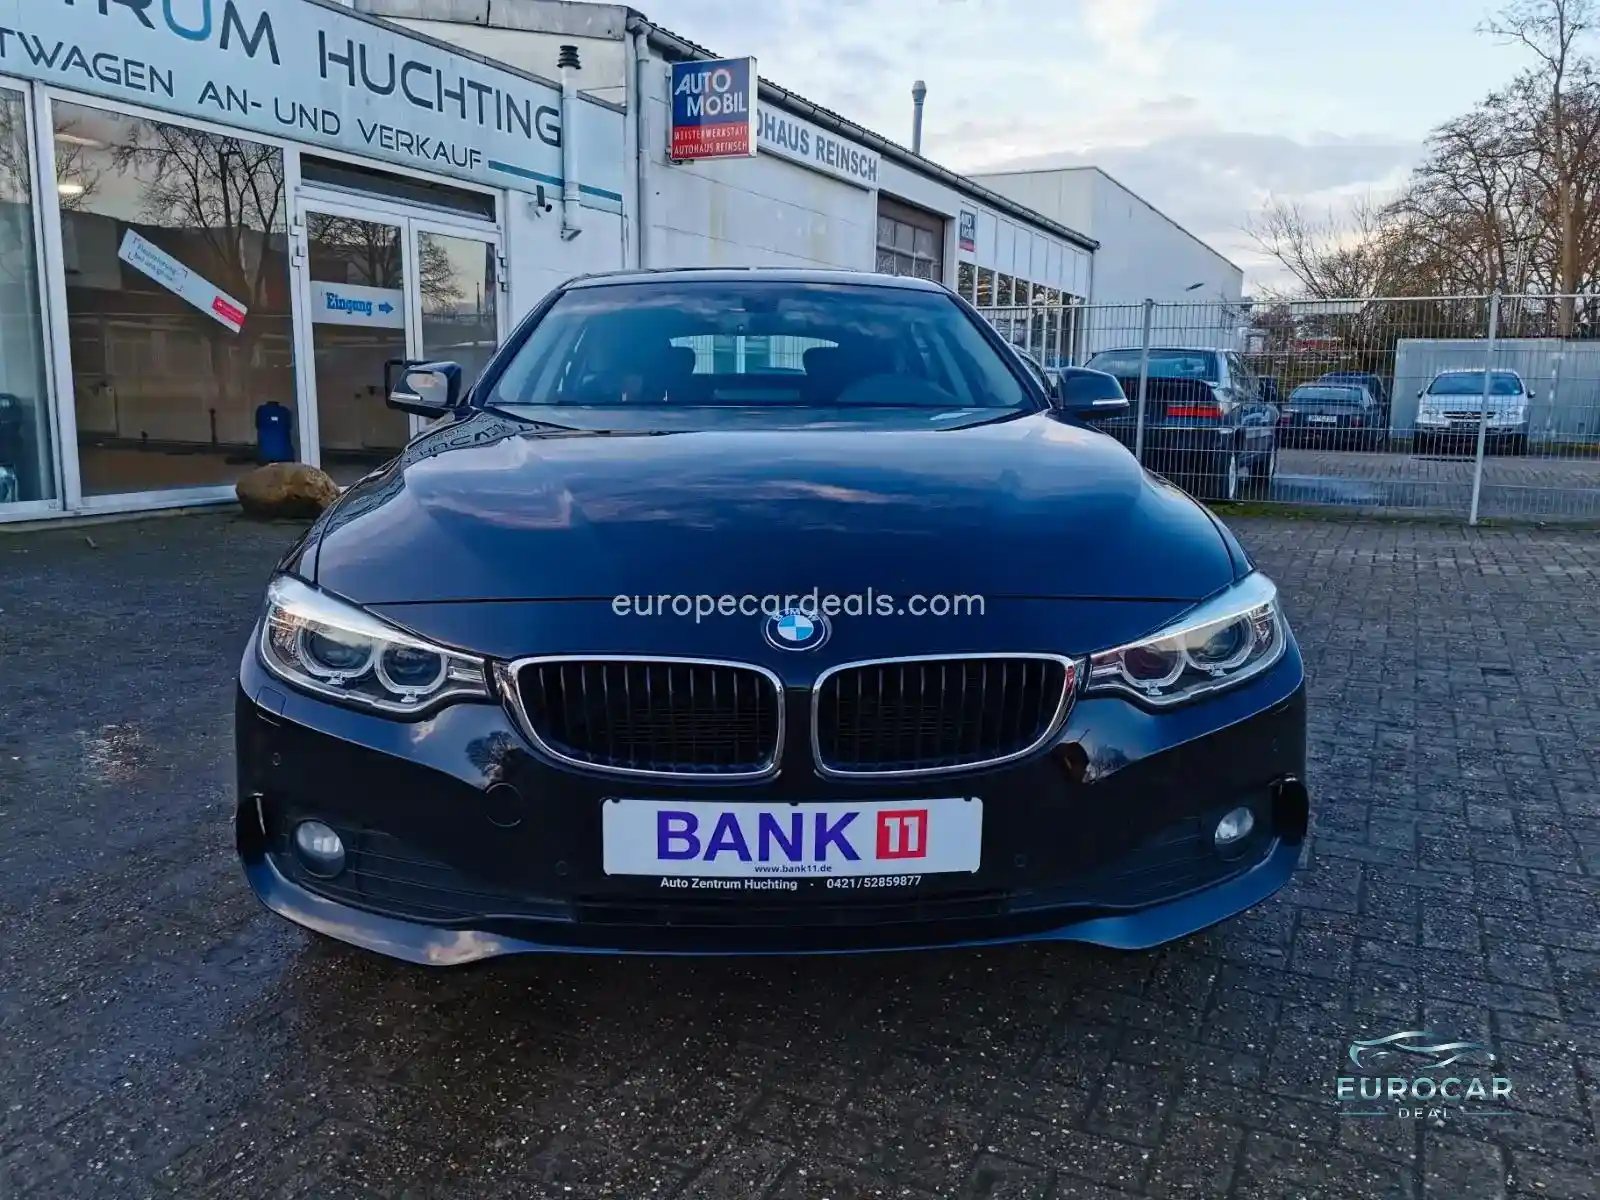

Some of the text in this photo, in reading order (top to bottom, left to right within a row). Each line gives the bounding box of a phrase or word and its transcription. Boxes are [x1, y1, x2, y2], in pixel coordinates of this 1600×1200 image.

[63, 0, 563, 148] UM HUCHTING
[674, 68, 732, 96] AUTO
[687, 91, 747, 117] MOBIL
[197, 80, 263, 116] AN-
[274, 97, 341, 137] UND
[356, 118, 483, 171] VERKAUF
[674, 125, 748, 140] MEISTERWERKSTATT
[674, 141, 748, 155] AUTOHAUS REINSCH
[815, 134, 878, 182] REINSCH
[325, 291, 373, 317] Eingang
[656, 810, 921, 862] BANK 11
[754, 864, 833, 874] www.bank11.de
[660, 875, 922, 892] Auto Zentrum Huchting 0421/52859877
